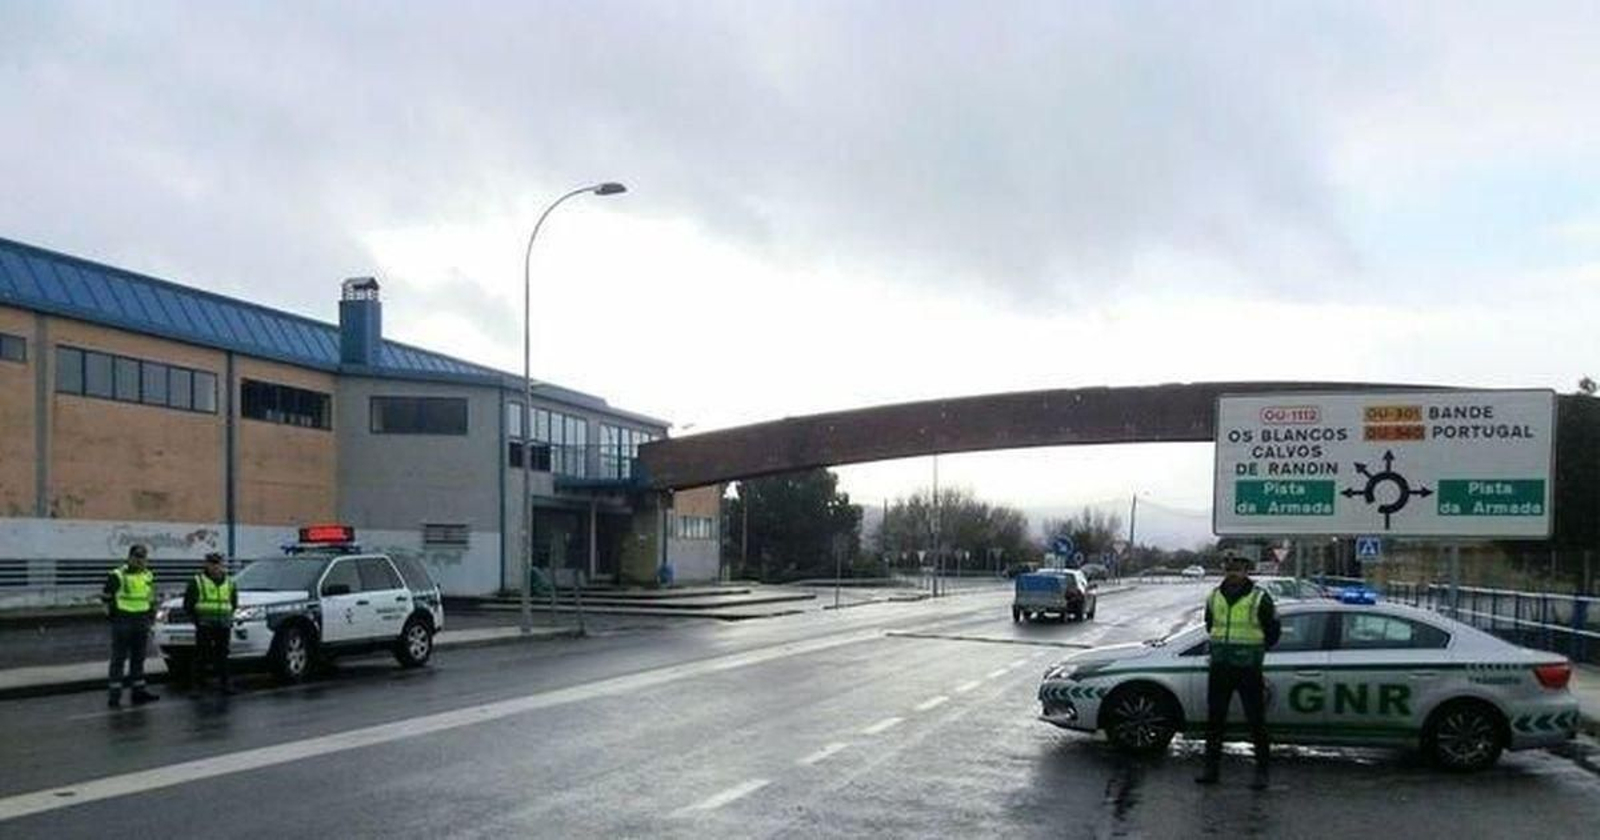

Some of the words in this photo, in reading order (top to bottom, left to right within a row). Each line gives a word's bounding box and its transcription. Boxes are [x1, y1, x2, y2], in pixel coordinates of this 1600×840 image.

[1429, 406, 1494, 420] BANDE
[1228, 430, 1253, 442] OS
[1261, 428, 1348, 442] BLANCOS
[1432, 425, 1533, 439] PORTUGAL
[1252, 445, 1323, 459] CALVOS
[1235, 463, 1258, 476] DE
[1268, 462, 1338, 475] RANDIN
[1263, 481, 1305, 495] Pista
[1468, 481, 1512, 495] Pista
[1237, 501, 1257, 513] da
[1268, 501, 1333, 513] Armada
[1439, 501, 1460, 514] da
[1472, 501, 1542, 514] Armada
[1288, 682, 1412, 715] GNR
